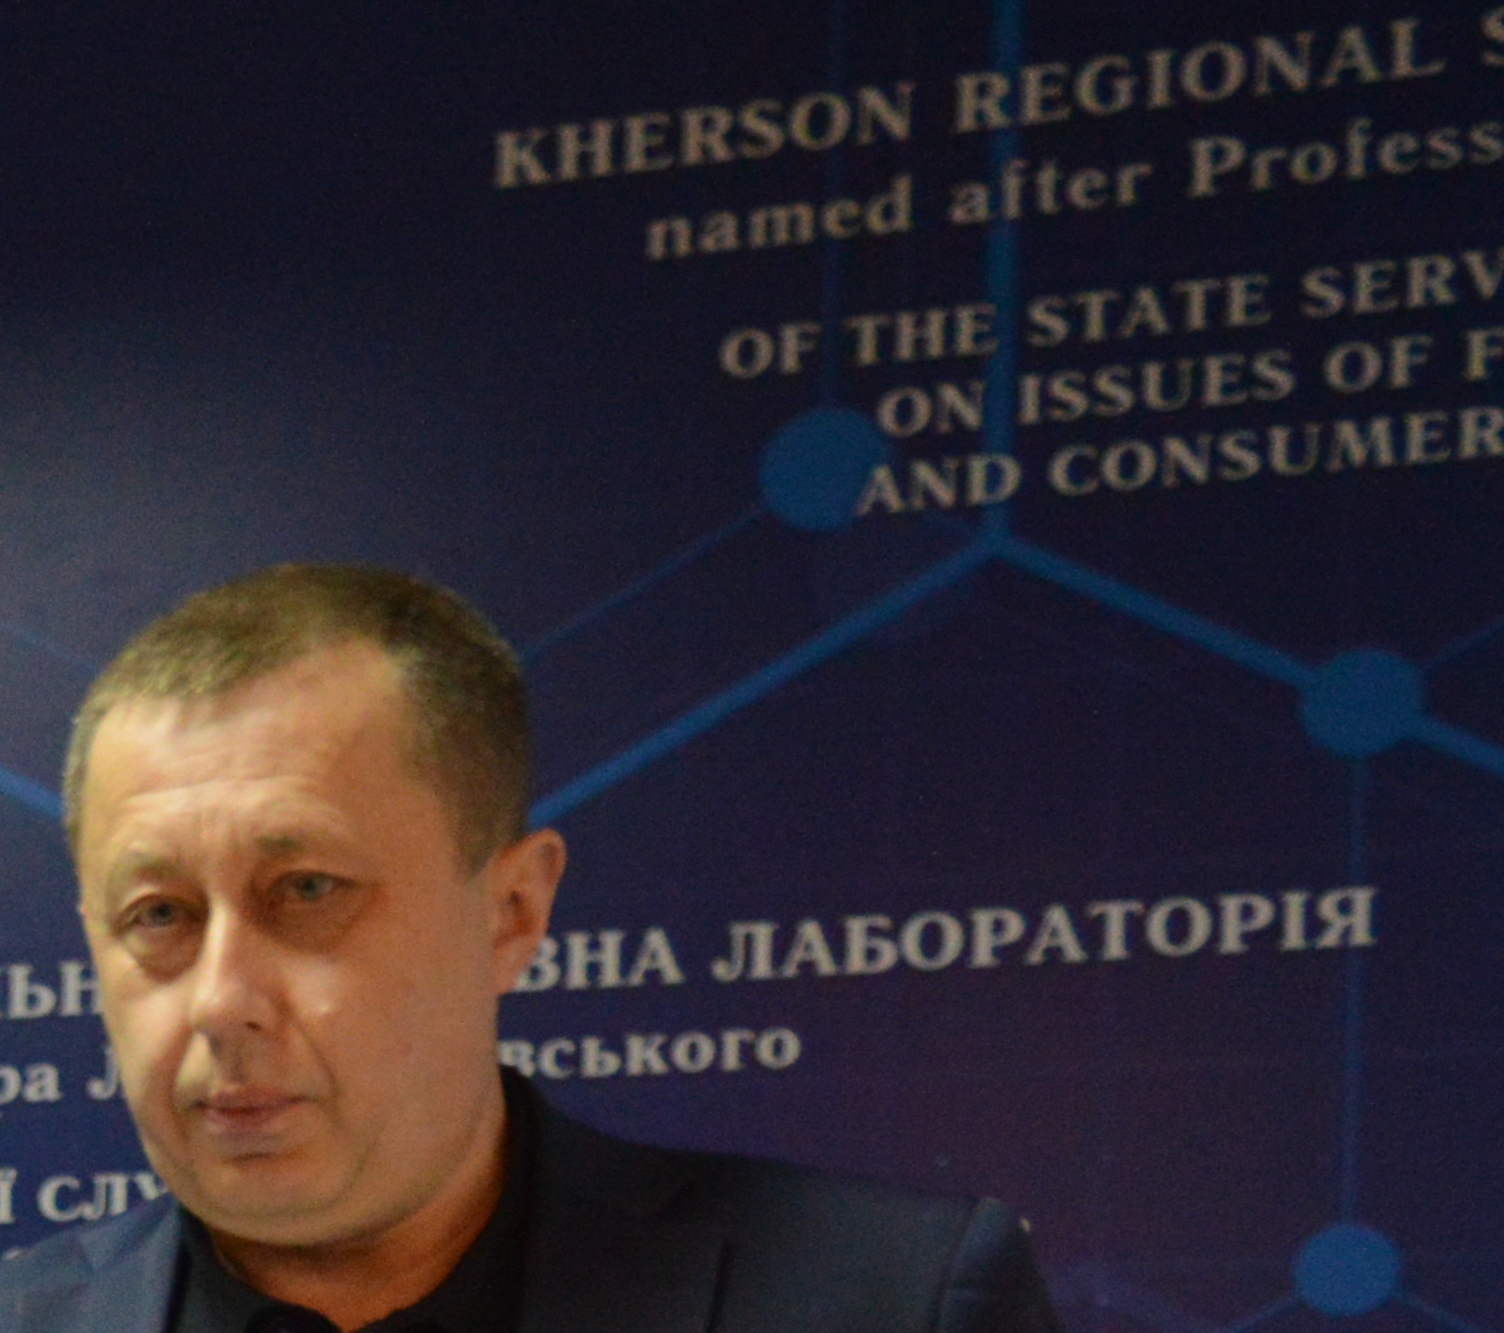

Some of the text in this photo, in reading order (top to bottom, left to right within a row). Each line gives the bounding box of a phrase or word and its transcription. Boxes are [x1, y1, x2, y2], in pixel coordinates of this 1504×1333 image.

[493, 85, 912, 190] KHERSON
[954, 18, 1445, 134] REGIONAL
[645, 173, 914, 262] named
[948, 157, 1154, 226] after
[718, 320, 820, 379] OF
[847, 302, 997, 367] THE
[1026, 274, 1267, 347] STATE
[874, 381, 985, 438] ON
[1017, 350, 1296, 426] ISSUES
[1323, 335, 1429, 391] OF
[854, 405, 1504, 518] AND CONSUMER
[709, 885, 1376, 983] ЛАБОРАТОРІЯ
